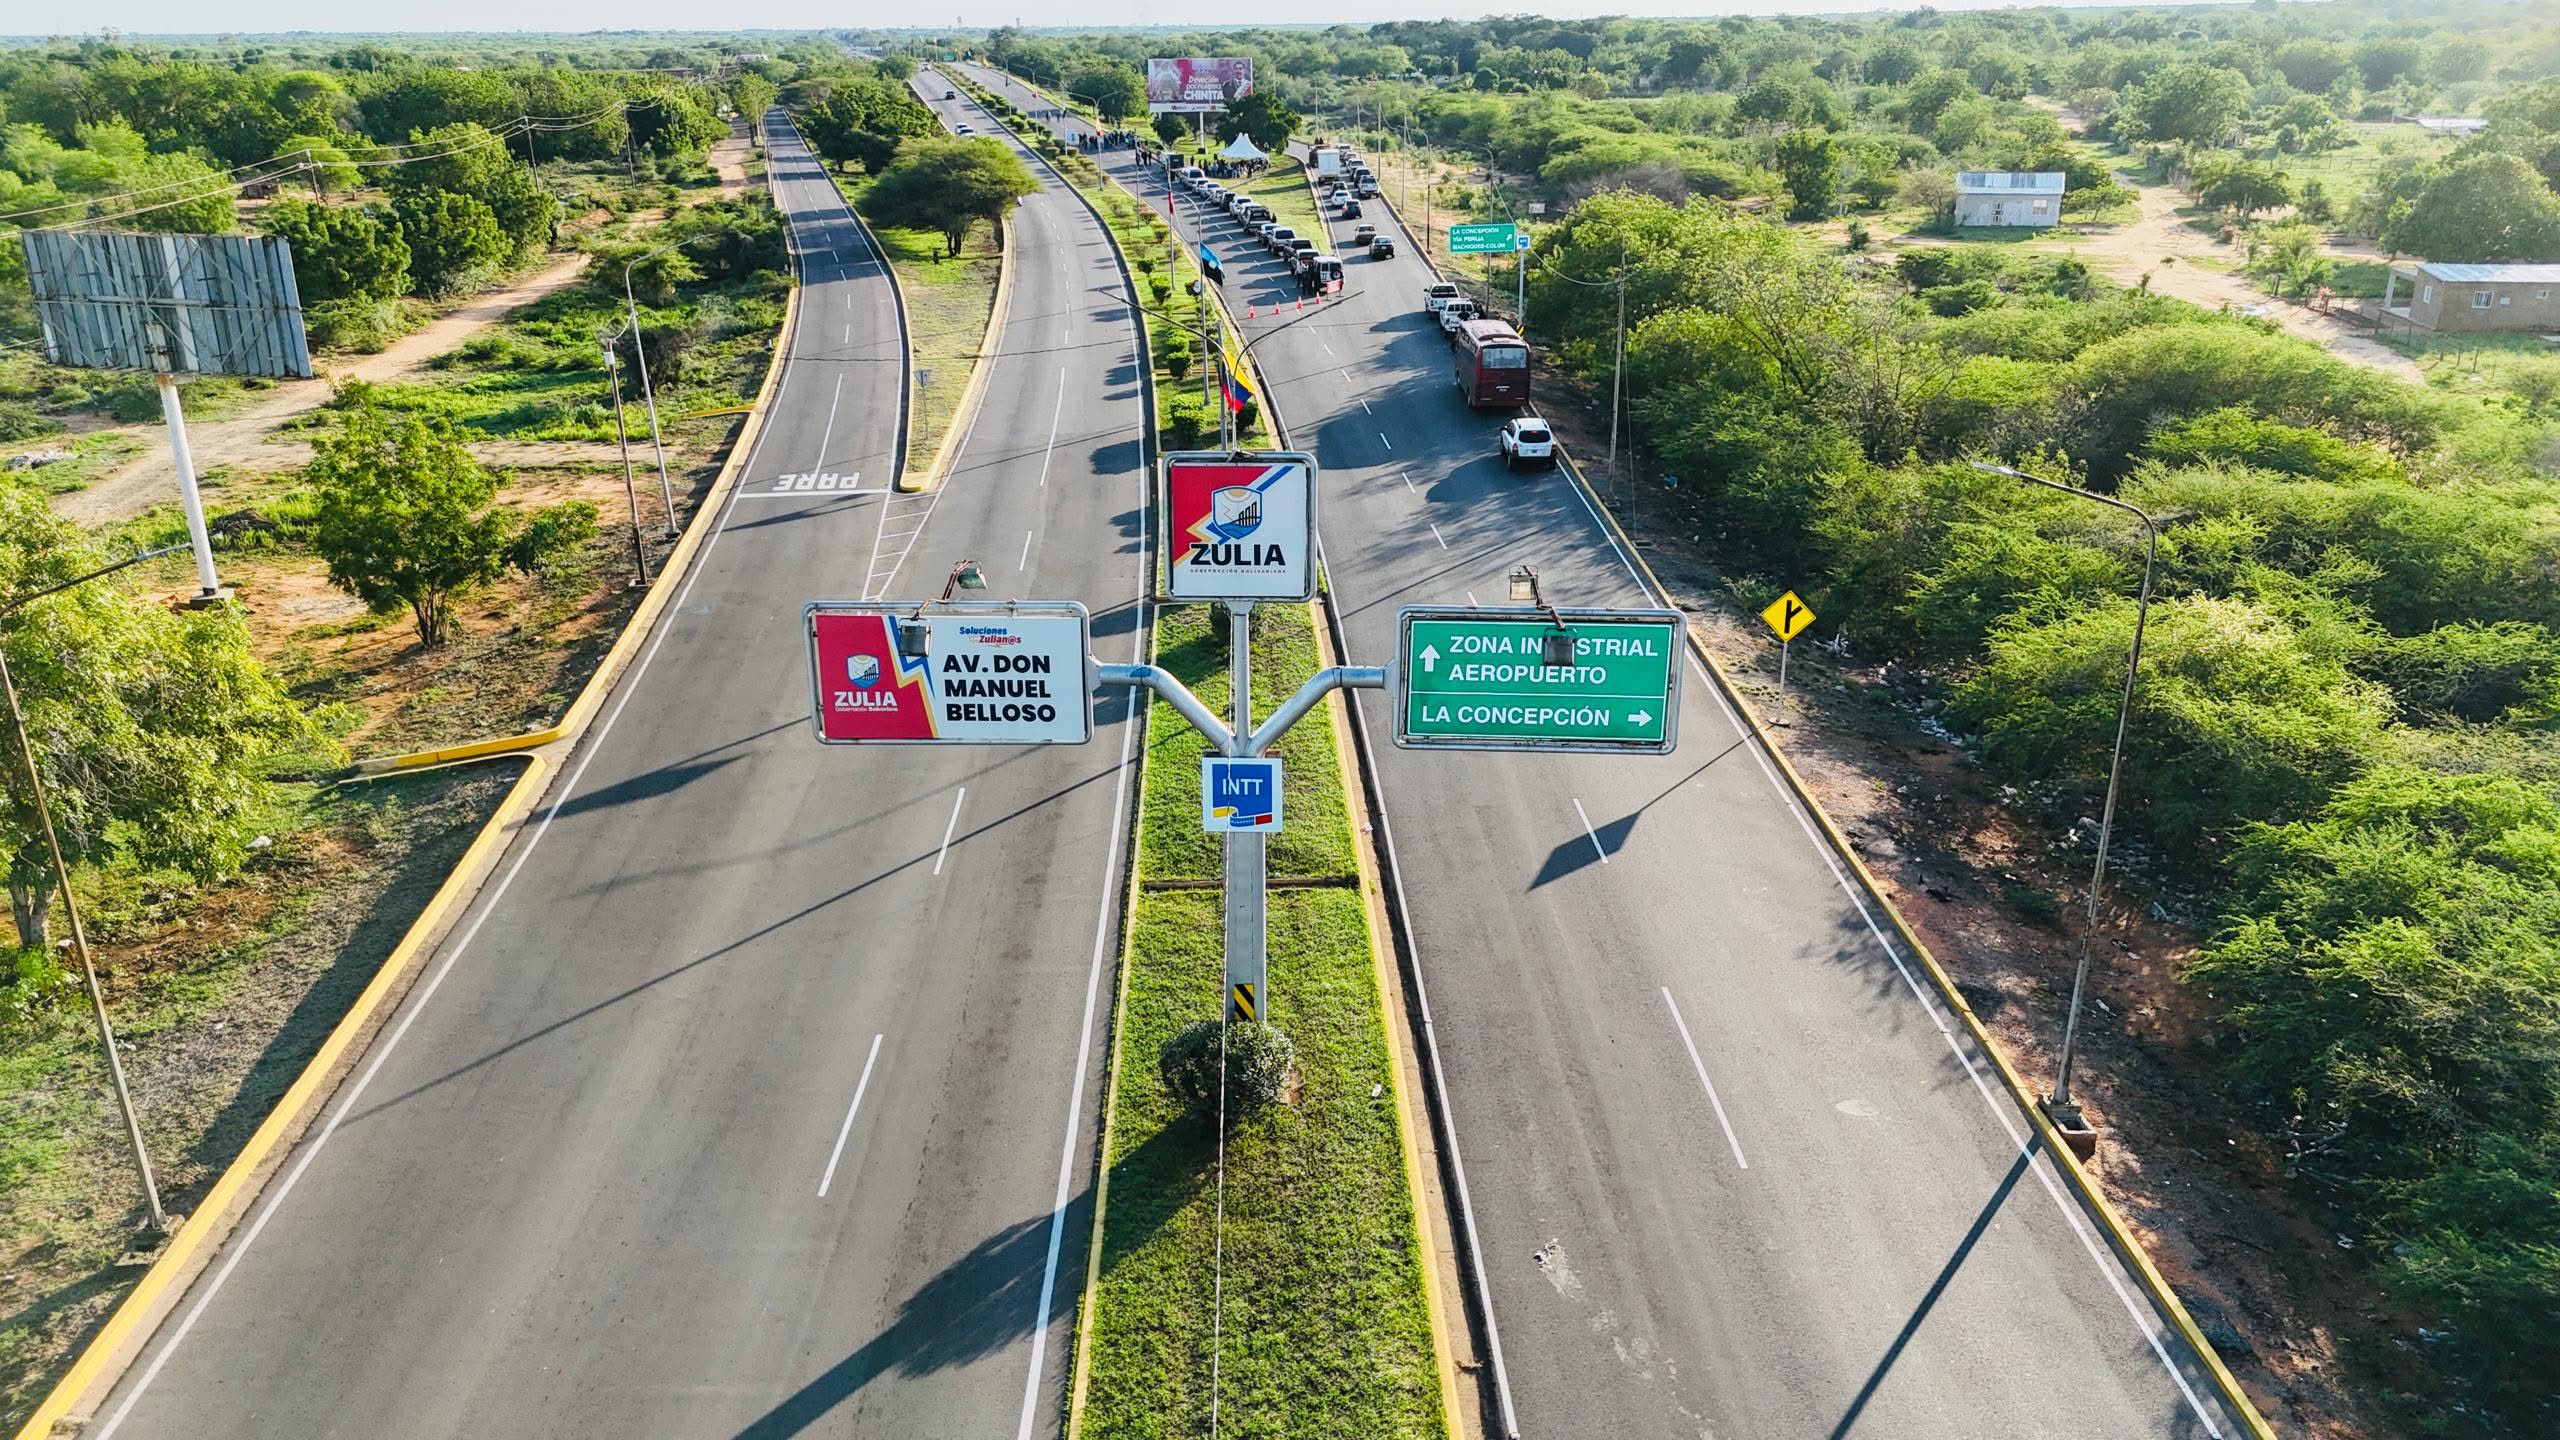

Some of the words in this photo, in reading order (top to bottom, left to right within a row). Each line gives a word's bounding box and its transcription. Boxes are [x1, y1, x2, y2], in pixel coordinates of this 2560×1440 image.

[1184, 90, 1224, 101] CHINITA
[772, 472, 861, 491] PARE
[1190, 543, 1286, 566] ZULIA
[959, 626, 1007, 635] Soluciones
[979, 635, 1022, 645] Zulian@s
[1449, 635, 1513, 655] ZONA
[1520, 637, 1659, 657] INSTRIAL
[942, 655, 989, 673] AV.
[993, 655, 1051, 674] DON
[1448, 664, 1607, 685] AEROPUERTO
[944, 679, 1052, 699] MANUEL
[834, 691, 898, 707] ZULIA
[946, 703, 1056, 723] BELLOSO
[1422, 705, 1450, 723] LA
[1458, 705, 1610, 727] CONCEPCIÓN
[1222, 778, 1264, 796] INTT
